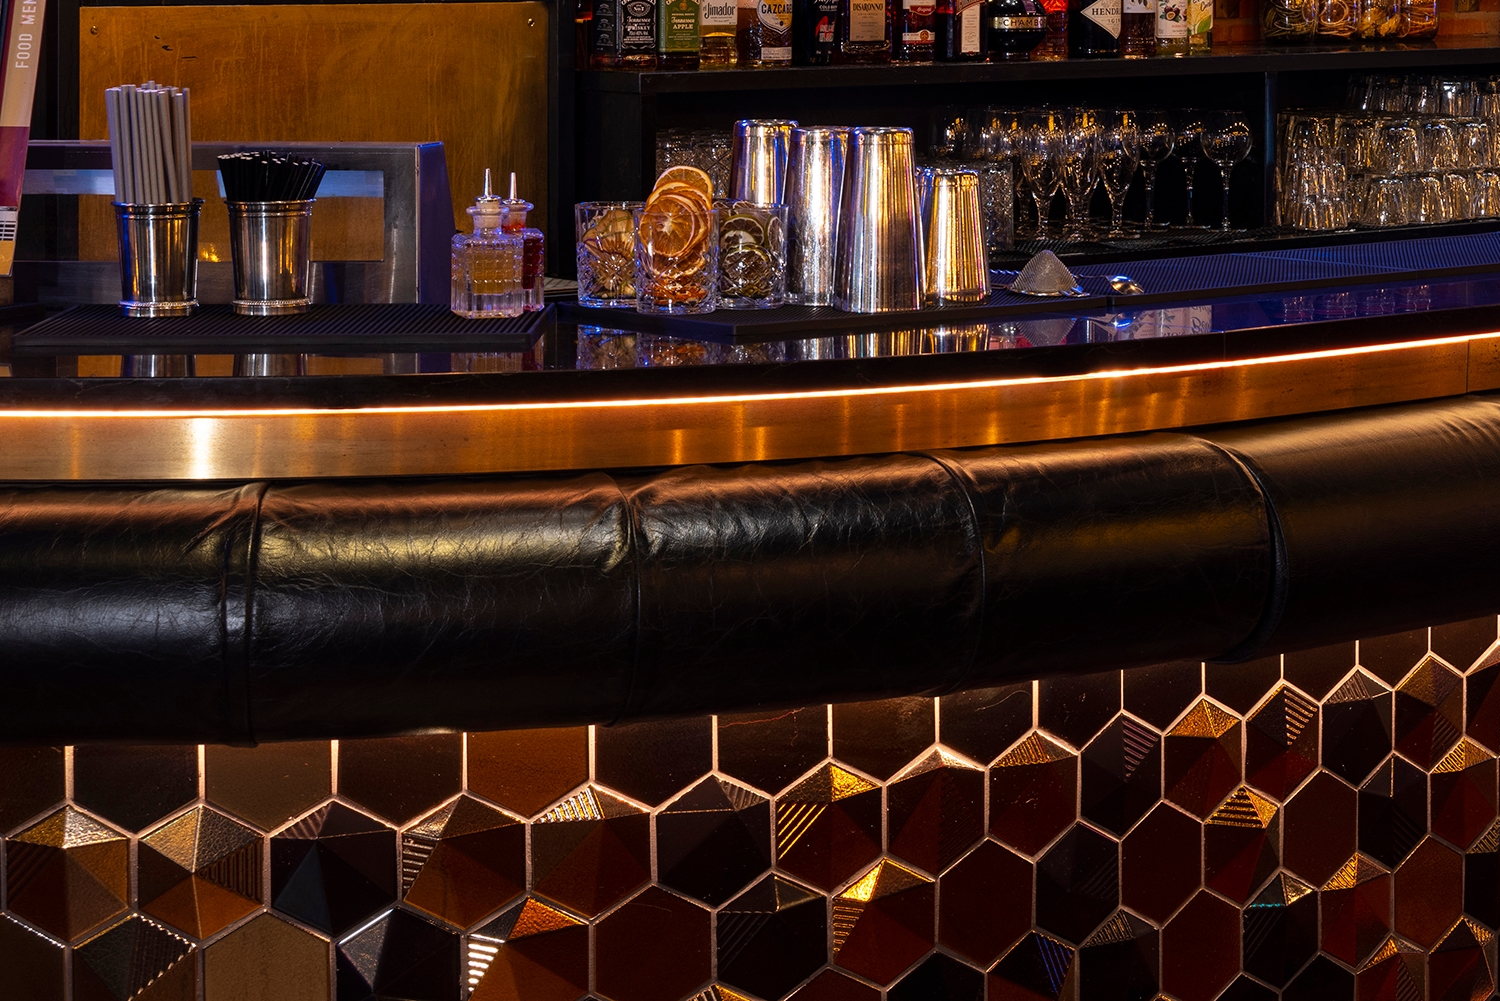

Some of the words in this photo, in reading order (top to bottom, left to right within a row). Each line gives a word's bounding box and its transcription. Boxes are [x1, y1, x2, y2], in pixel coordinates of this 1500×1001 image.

[704, 1, 736, 20] Jimador
[761, 3, 793, 15] CAZCABE
[852, 1, 885, 12] DISARONNO
[1091, 7, 1121, 17] HENDR
[1003, 18, 1046, 28] CHAMBO
[15, 32, 33, 69] FOOD
